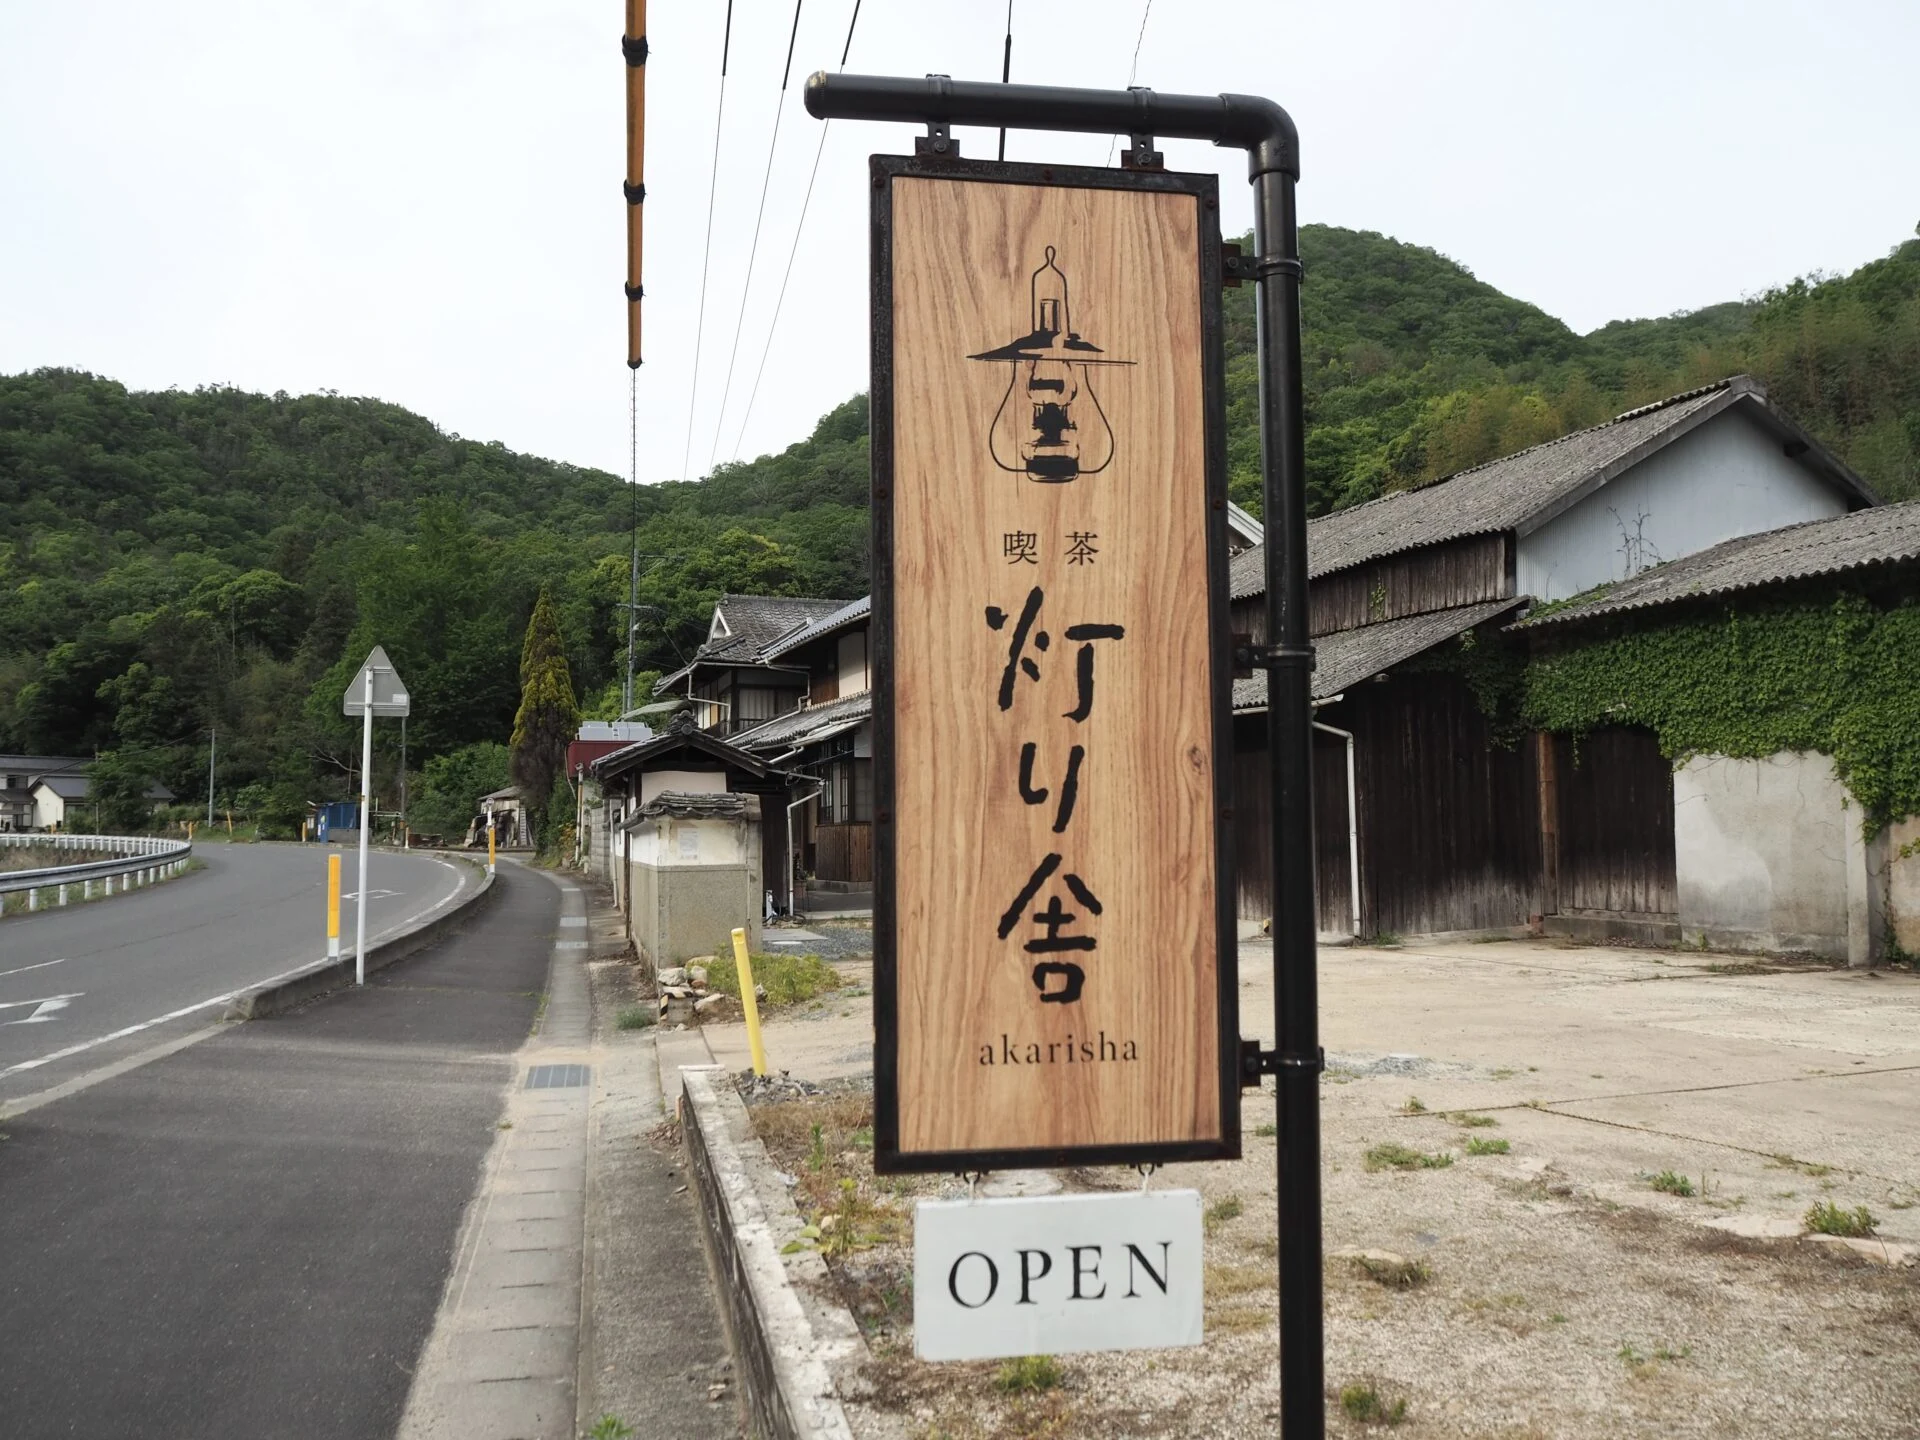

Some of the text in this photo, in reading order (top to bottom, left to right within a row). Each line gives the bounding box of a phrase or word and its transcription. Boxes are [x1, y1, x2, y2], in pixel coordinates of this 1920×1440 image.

[1003, 530, 1099, 566] 喫茶
[984, 586, 1125, 1005] 灯り舎
[979, 1031, 1138, 1067] akarisha
[948, 1240, 1172, 1308] OPEN
